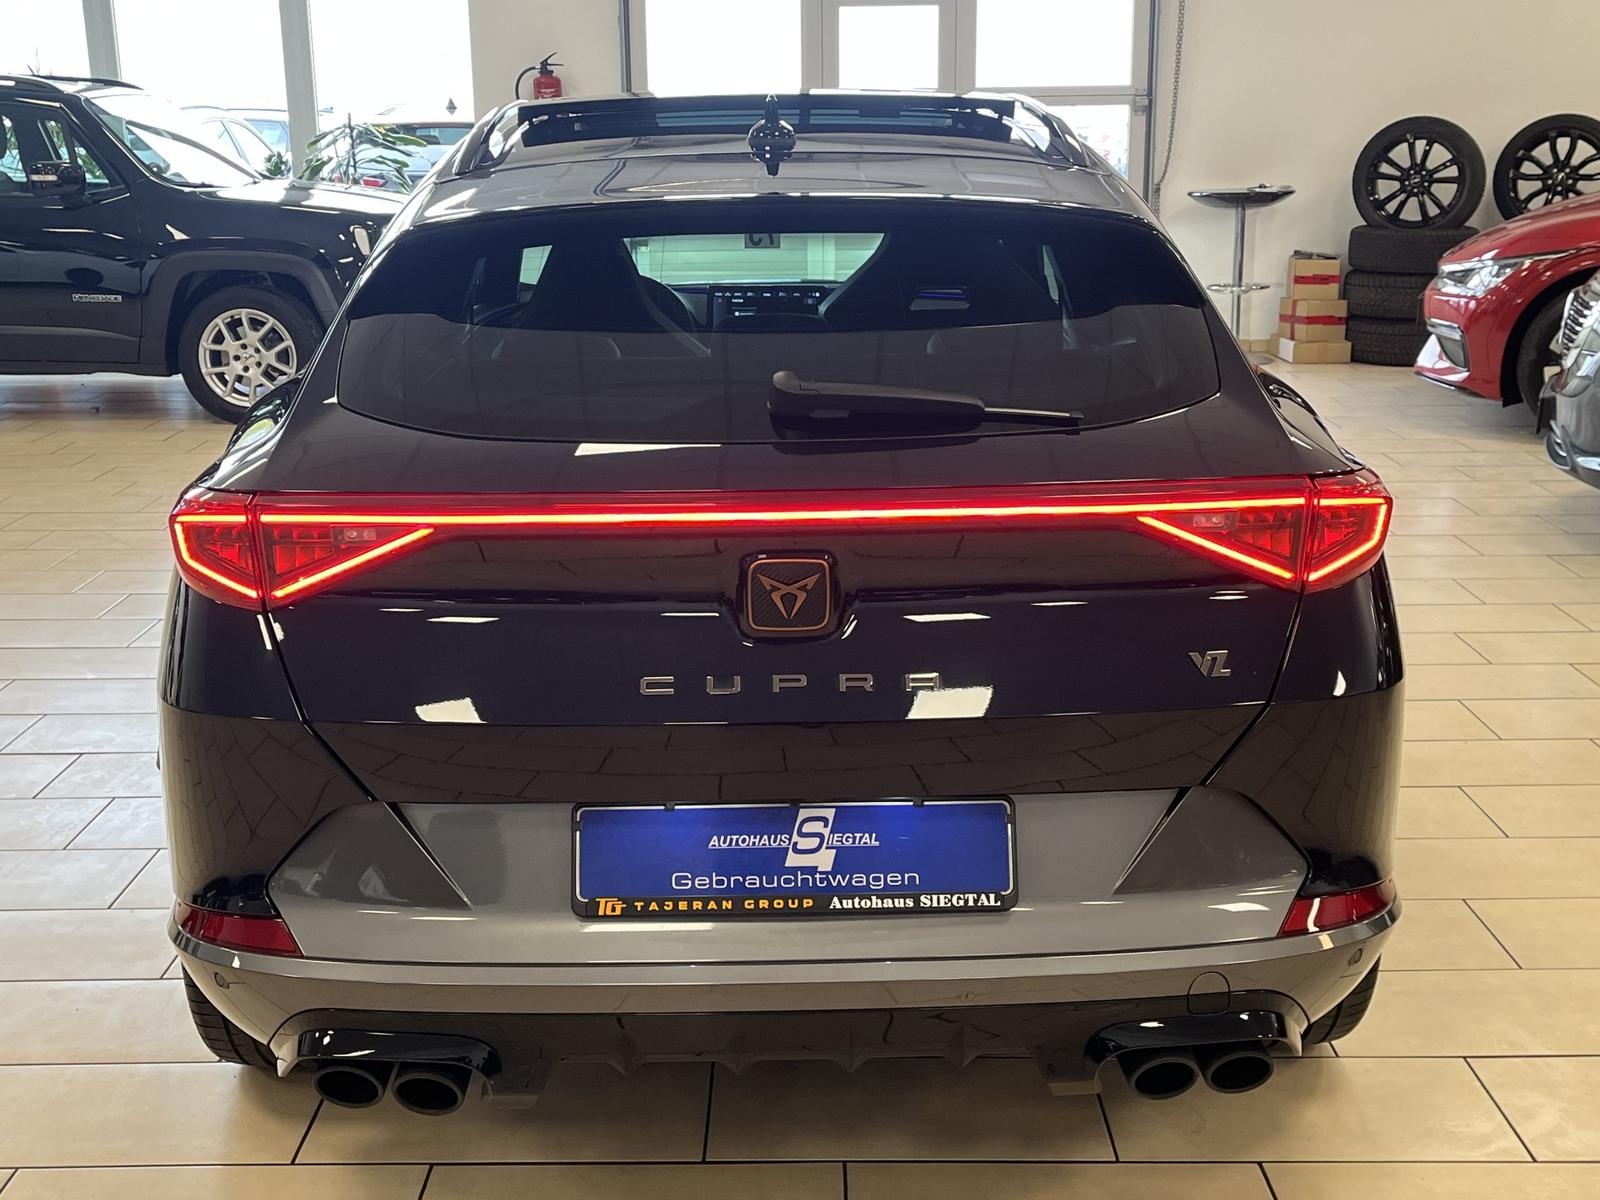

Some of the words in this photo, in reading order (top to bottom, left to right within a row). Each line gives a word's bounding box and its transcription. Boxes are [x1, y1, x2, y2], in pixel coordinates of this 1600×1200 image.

[639, 672, 940, 695] CUPRA
[708, 833, 790, 848] AUTOHAUS
[671, 870, 920, 890] Gebrauchtwagen
[595, 897, 627, 916] TG
[634, 900, 732, 911] TAJERAN
[744, 898, 814, 909] GROUP
[829, 896, 914, 909] Autohaus
[919, 893, 1001, 908] SIEGTAL
